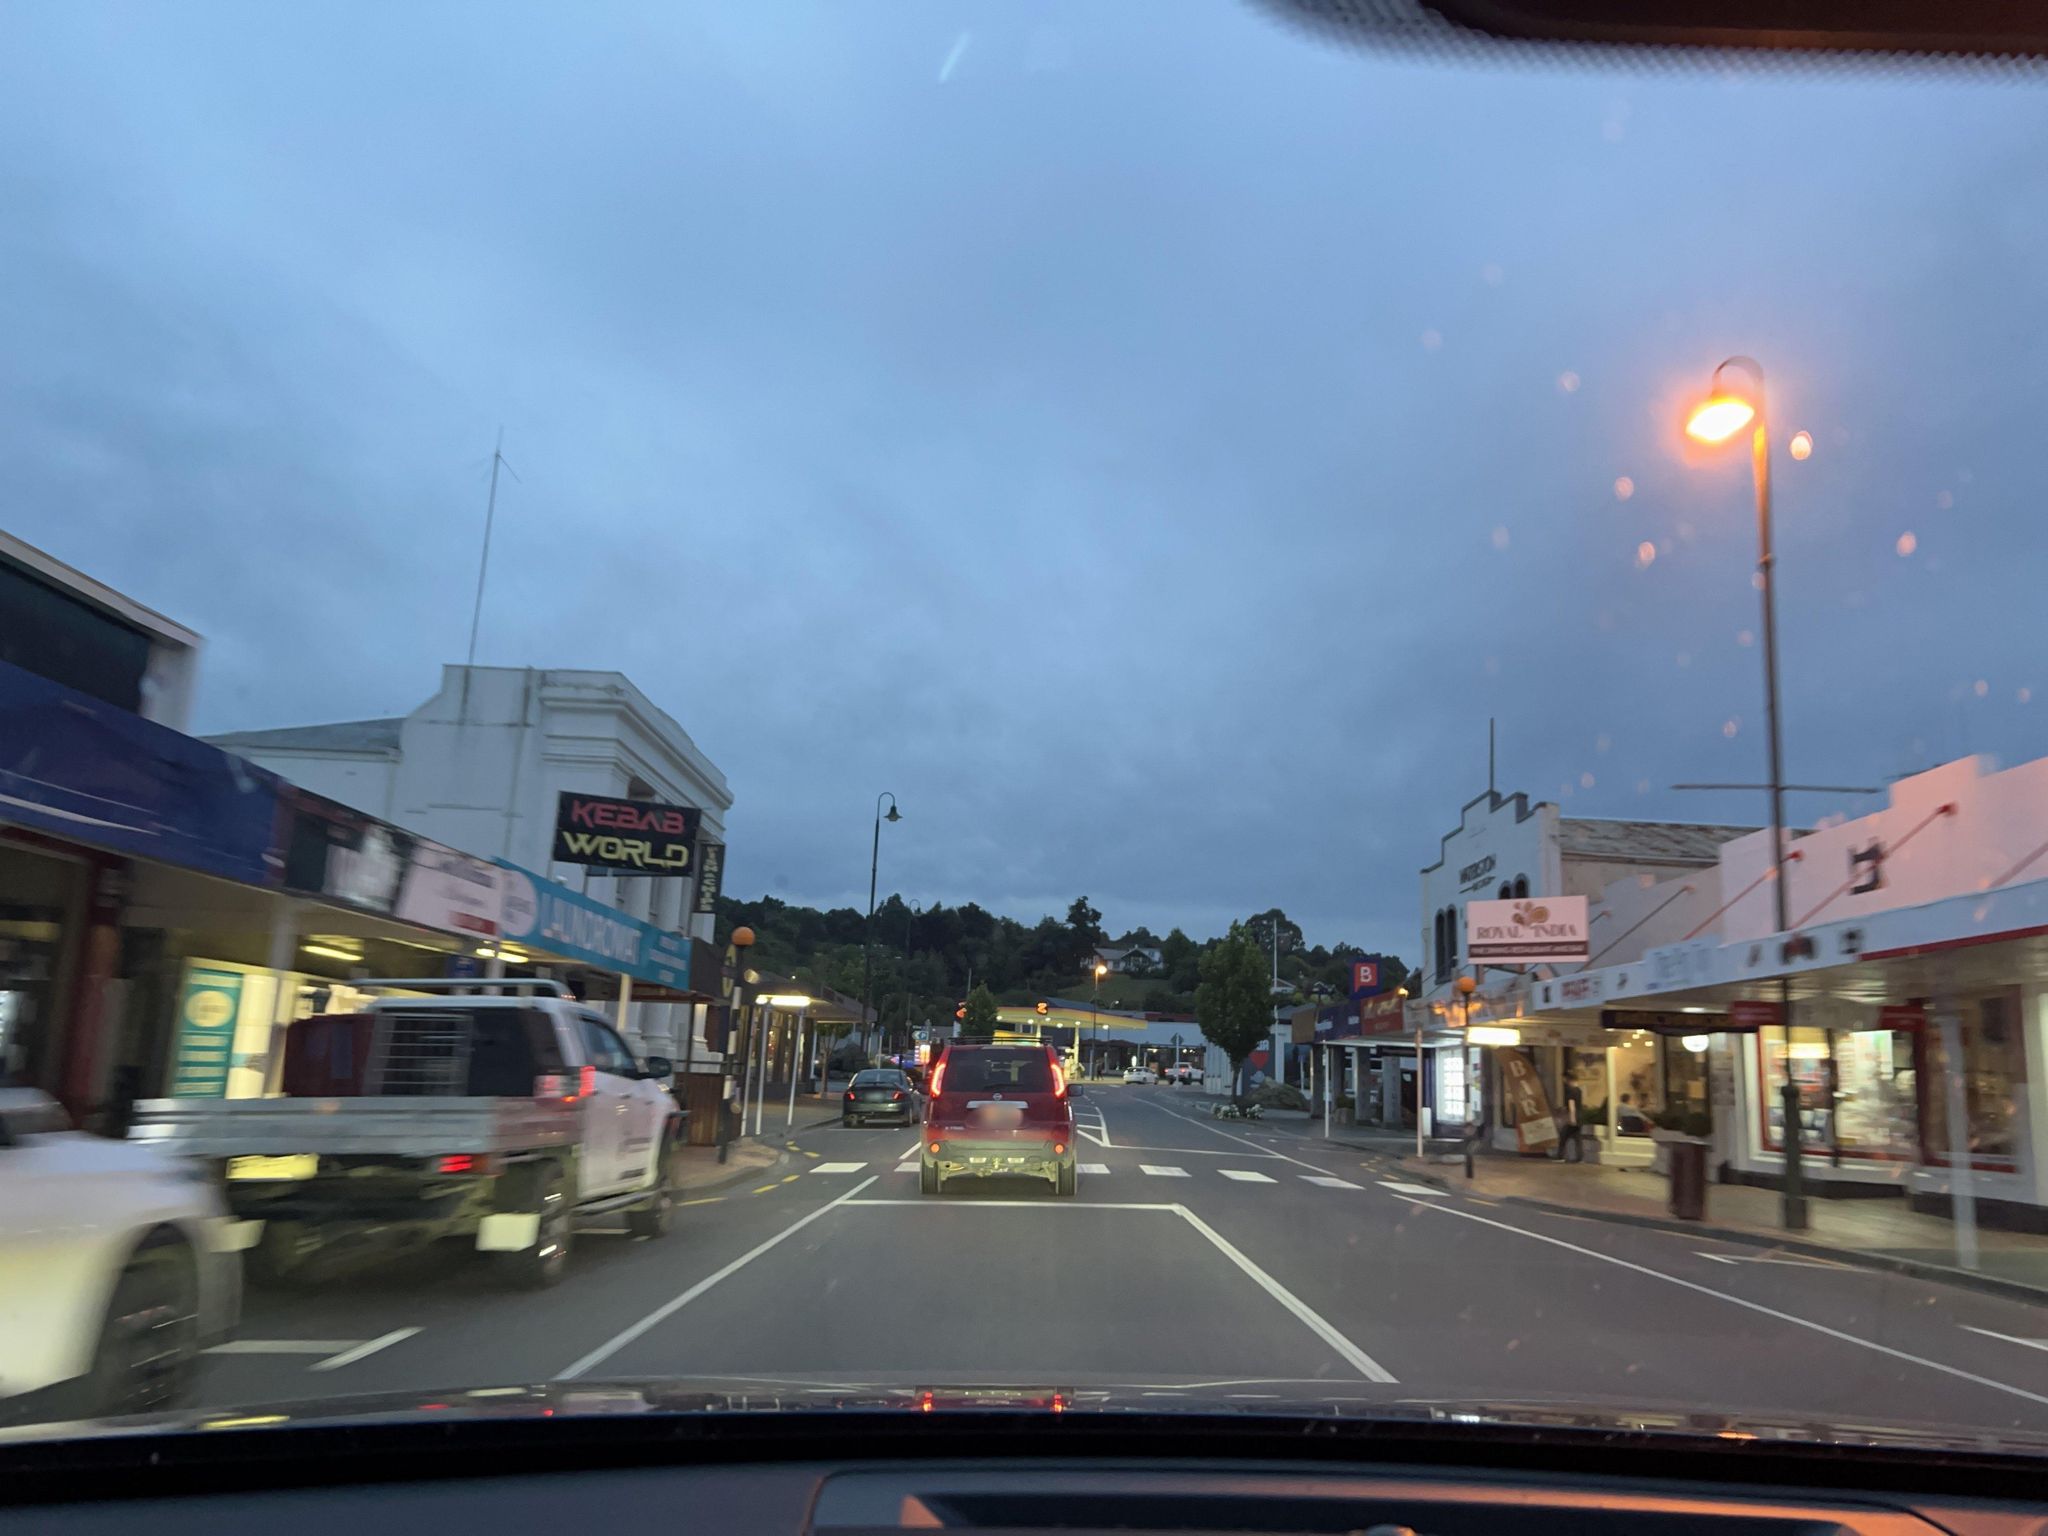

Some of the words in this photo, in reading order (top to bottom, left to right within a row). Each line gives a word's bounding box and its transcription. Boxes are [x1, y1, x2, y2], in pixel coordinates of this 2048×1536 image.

[571, 800, 685, 835] KEBAB
[562, 831, 689, 869] WORLD
[1476, 926, 1524, 940] ROYAL
[1530, 923, 1577, 938] INDIA
[1360, 966, 1372, 983] B
